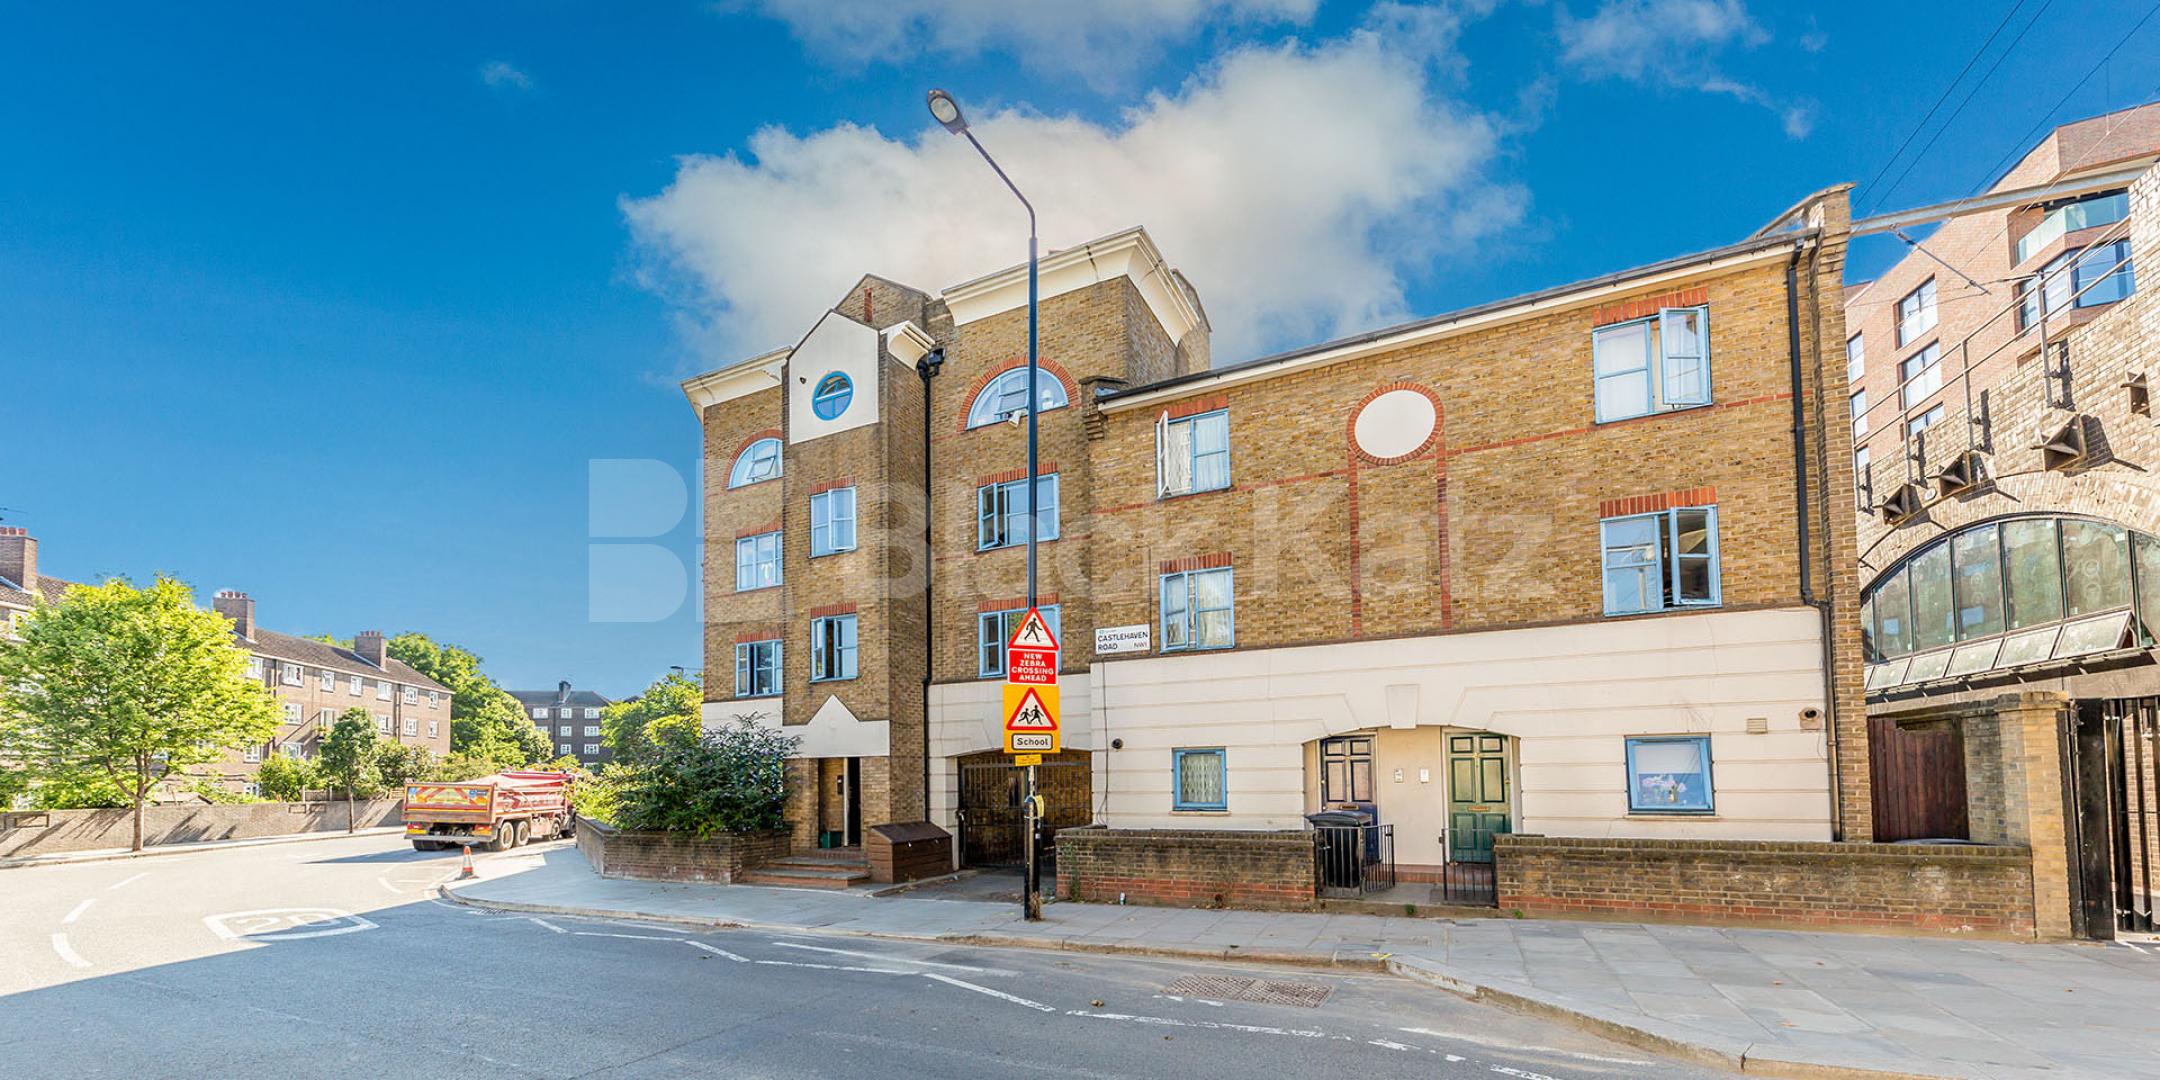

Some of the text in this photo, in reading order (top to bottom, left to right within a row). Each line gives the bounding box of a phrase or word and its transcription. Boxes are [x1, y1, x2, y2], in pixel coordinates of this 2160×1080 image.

[1097, 631, 1148, 642] CASTLEHAVEN
[1097, 643, 1118, 651] ROAD
[1019, 659, 1046, 667] ZEBRA
[1011, 666, 1054, 675] CROSSING
[1018, 674, 1047, 682] AHEAD
[1016, 737, 1049, 746] School
